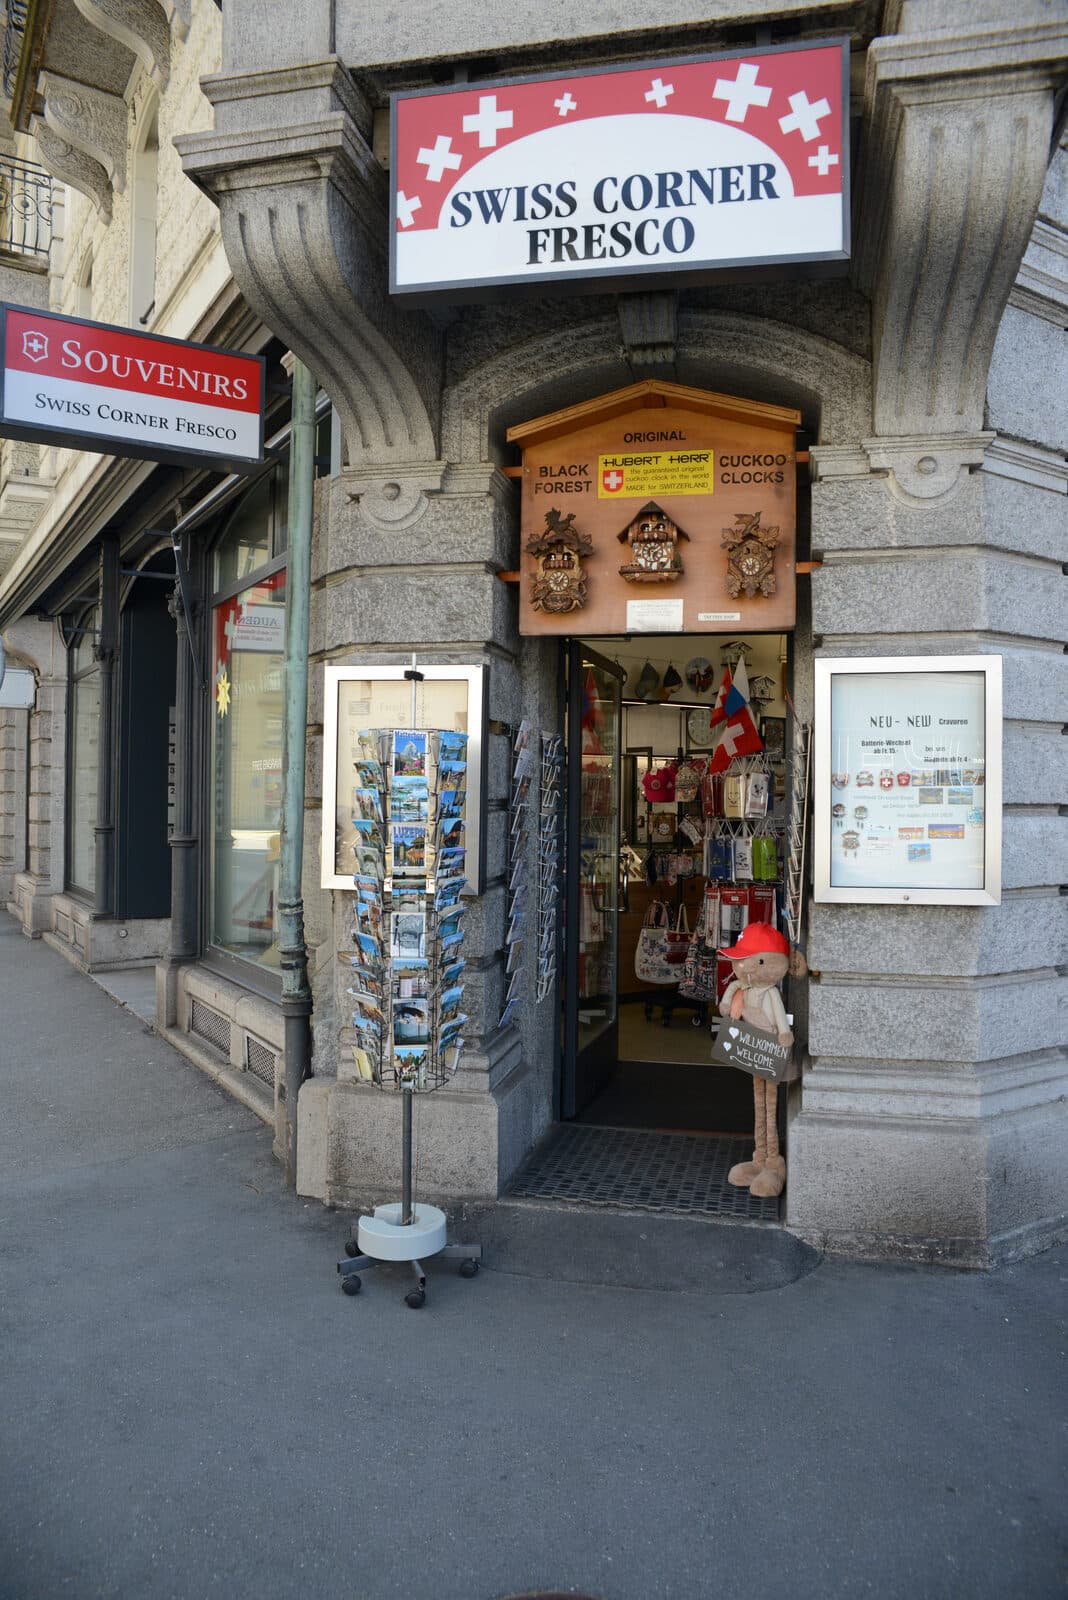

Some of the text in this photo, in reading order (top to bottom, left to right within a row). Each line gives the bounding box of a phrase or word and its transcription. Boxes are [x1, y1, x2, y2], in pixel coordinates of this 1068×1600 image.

[450, 162, 780, 228] SWISS CORNER
[526, 216, 695, 265] FRESCO
[61, 340, 248, 400] SOUVENIRS
[35, 393, 237, 441] SWISS CORNER FRESCO
[623, 431, 687, 443] ORIGINAL
[719, 454, 787, 467] CUCKOO
[539, 464, 589, 477] BLACK
[643, 466, 680, 475] guaranteed
[681, 465, 705, 473] original
[626, 475, 649, 483] cuckoo
[720, 471, 785, 485] CLOCKS
[534, 481, 592, 494] FOREST
[660, 482, 709, 490] SWITZERLAND
[907, 714, 932, 727] NEW
[739, 1031, 789, 1060] WILLKOMMEN
[736, 1045, 776, 1069] WELCOME
